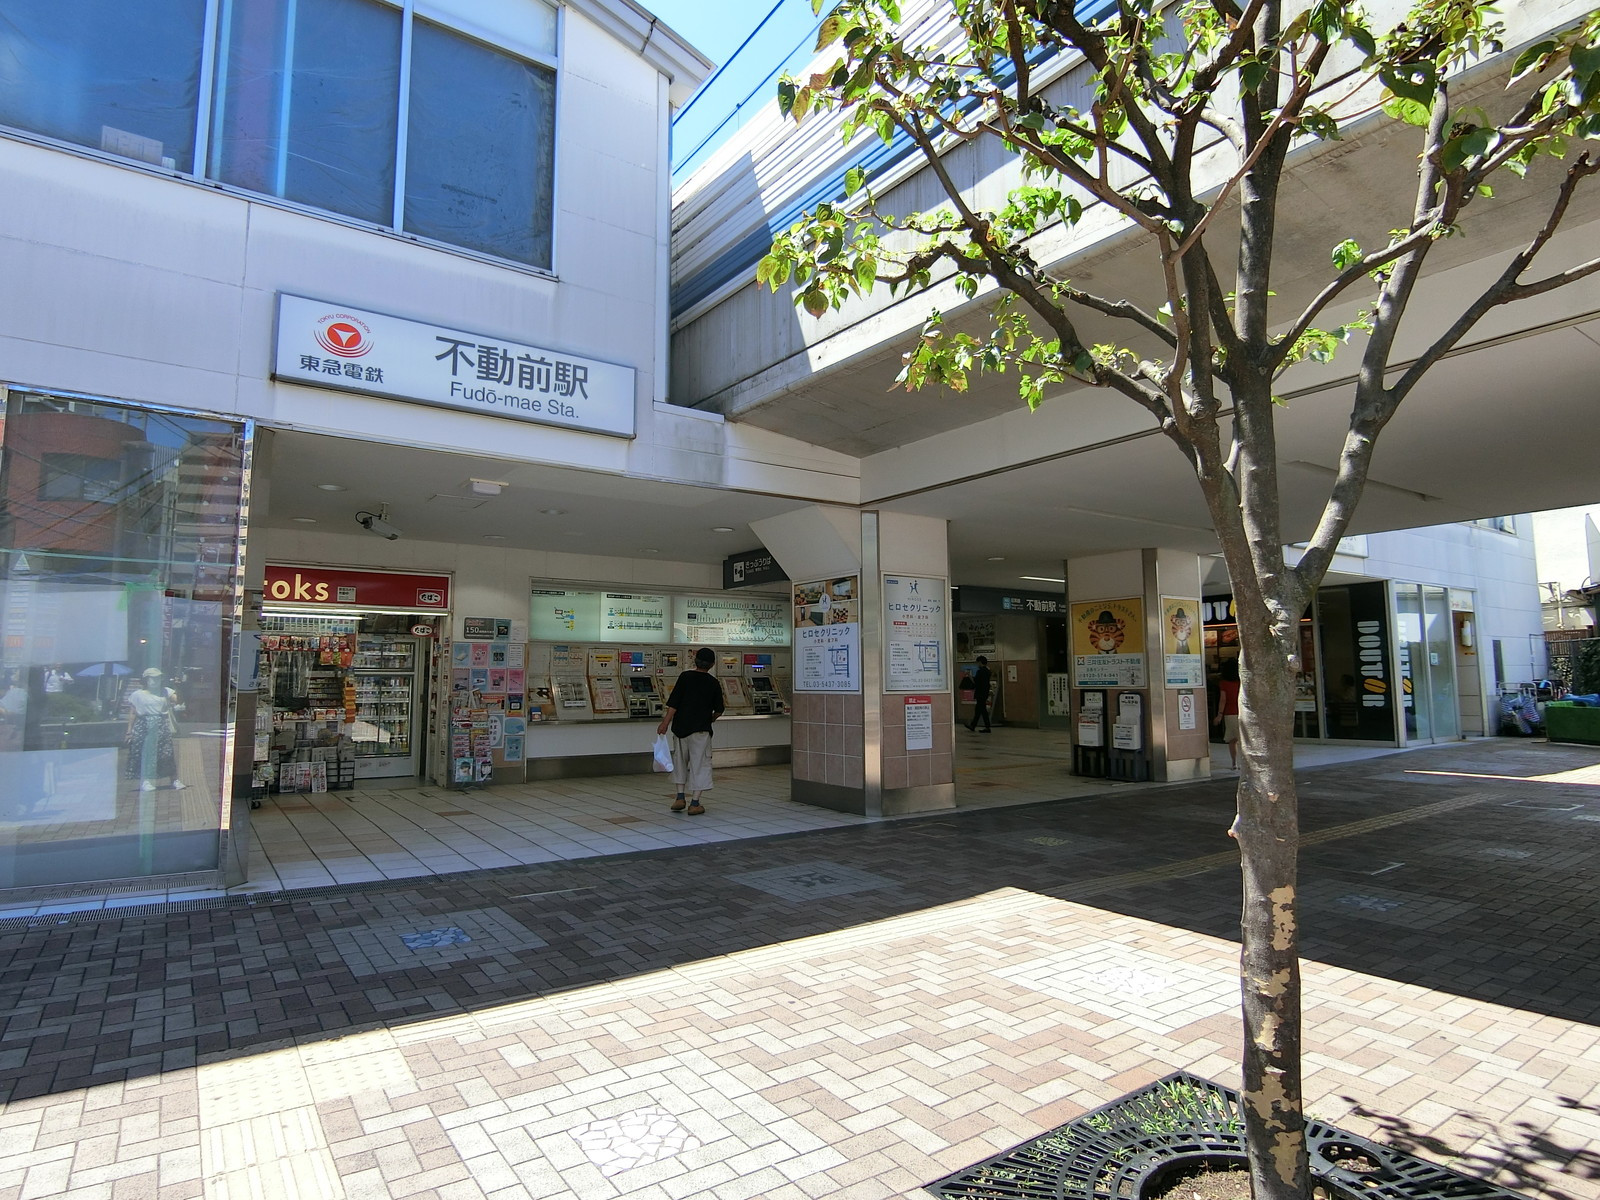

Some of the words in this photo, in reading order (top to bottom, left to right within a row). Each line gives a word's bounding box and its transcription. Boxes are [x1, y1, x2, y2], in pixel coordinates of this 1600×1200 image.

[317, 314, 334, 324] TOKYU
[336, 313, 371, 334] CORPORATION
[300, 354, 384, 384] 東急電鉄
[435, 335, 588, 400] 不動前駅
[450, 381, 542, 412] Fudō-mae
[547, 399, 580, 419] Sta.
[745, 555, 772, 569] きっぷうりば
[263, 573, 329, 601] oks
[421, 593, 440, 602] たばこ
[889, 602, 941, 613] ヒロセクリニック
[1025, 599, 1057, 612] 不動前駅
[414, 626, 432, 636] たばこ
[466, 626, 480, 634] 150
[802, 626, 850, 639] ヒロセクリニック
